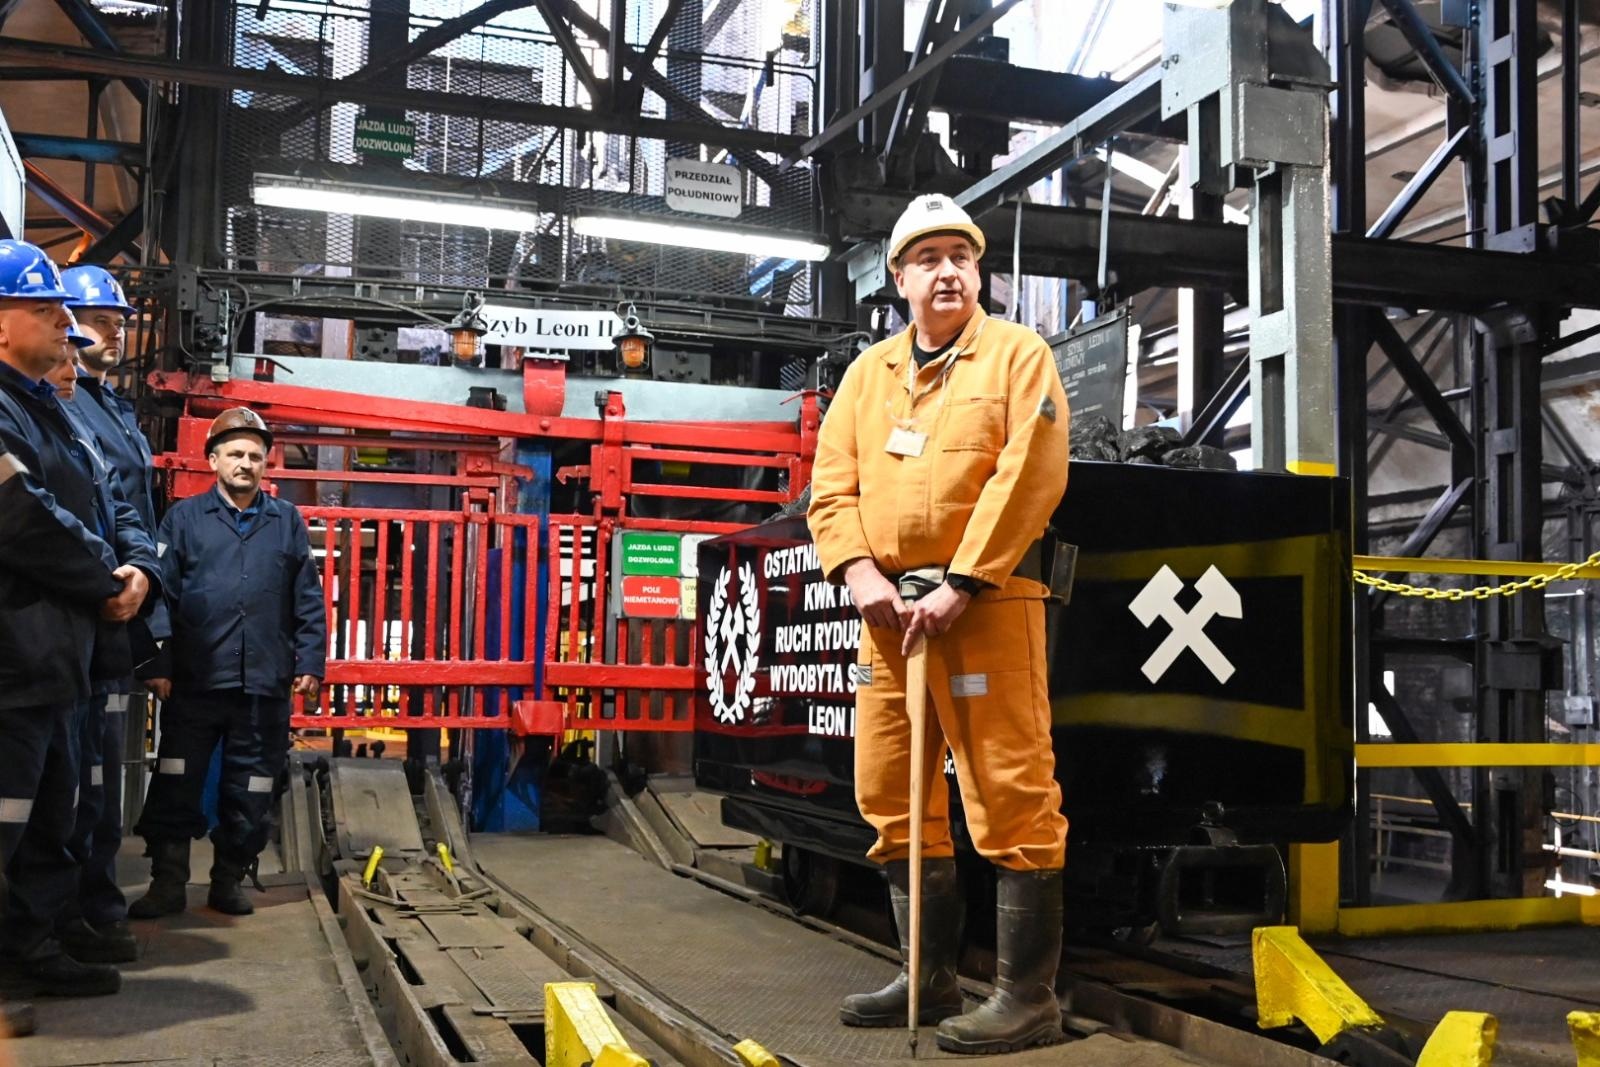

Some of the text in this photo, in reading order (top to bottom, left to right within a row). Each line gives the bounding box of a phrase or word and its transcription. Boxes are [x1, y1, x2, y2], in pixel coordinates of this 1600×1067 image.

[357, 120, 413, 136] JAZDA LUDZI
[356, 137, 412, 153] DOZWOLONA
[674, 170, 732, 185] PRZEDZIAŁ
[667, 186, 739, 203] POŁUDNIOWY
[477, 312, 527, 338] Szyb
[536, 317, 589, 337] Leon
[628, 543, 675, 552] JAZDA LUDZI
[628, 556, 674, 564] DOZWOLONA
[642, 586, 661, 594] POLE
[804, 581, 837, 612] KWK
[775, 623, 812, 653] RUCH
[770, 663, 844, 693] WYDOBYTA
[808, 705, 846, 736] LEON
